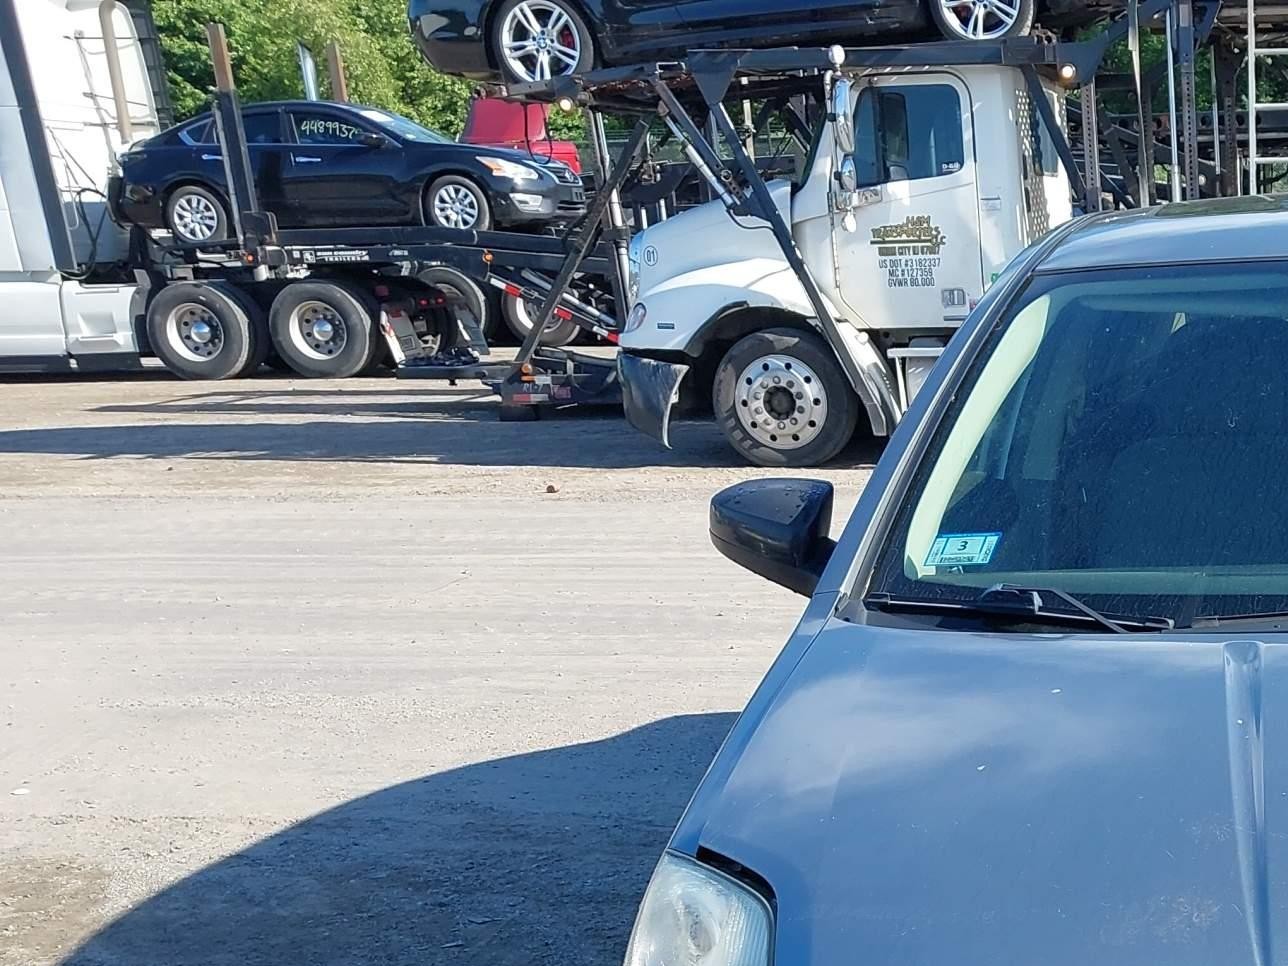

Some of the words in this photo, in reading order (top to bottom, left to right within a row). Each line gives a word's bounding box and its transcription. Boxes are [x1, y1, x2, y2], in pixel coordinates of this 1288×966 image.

[879, 259, 888, 268] US
[889, 259, 903, 268] DOT
[888, 268, 900, 277] MC
